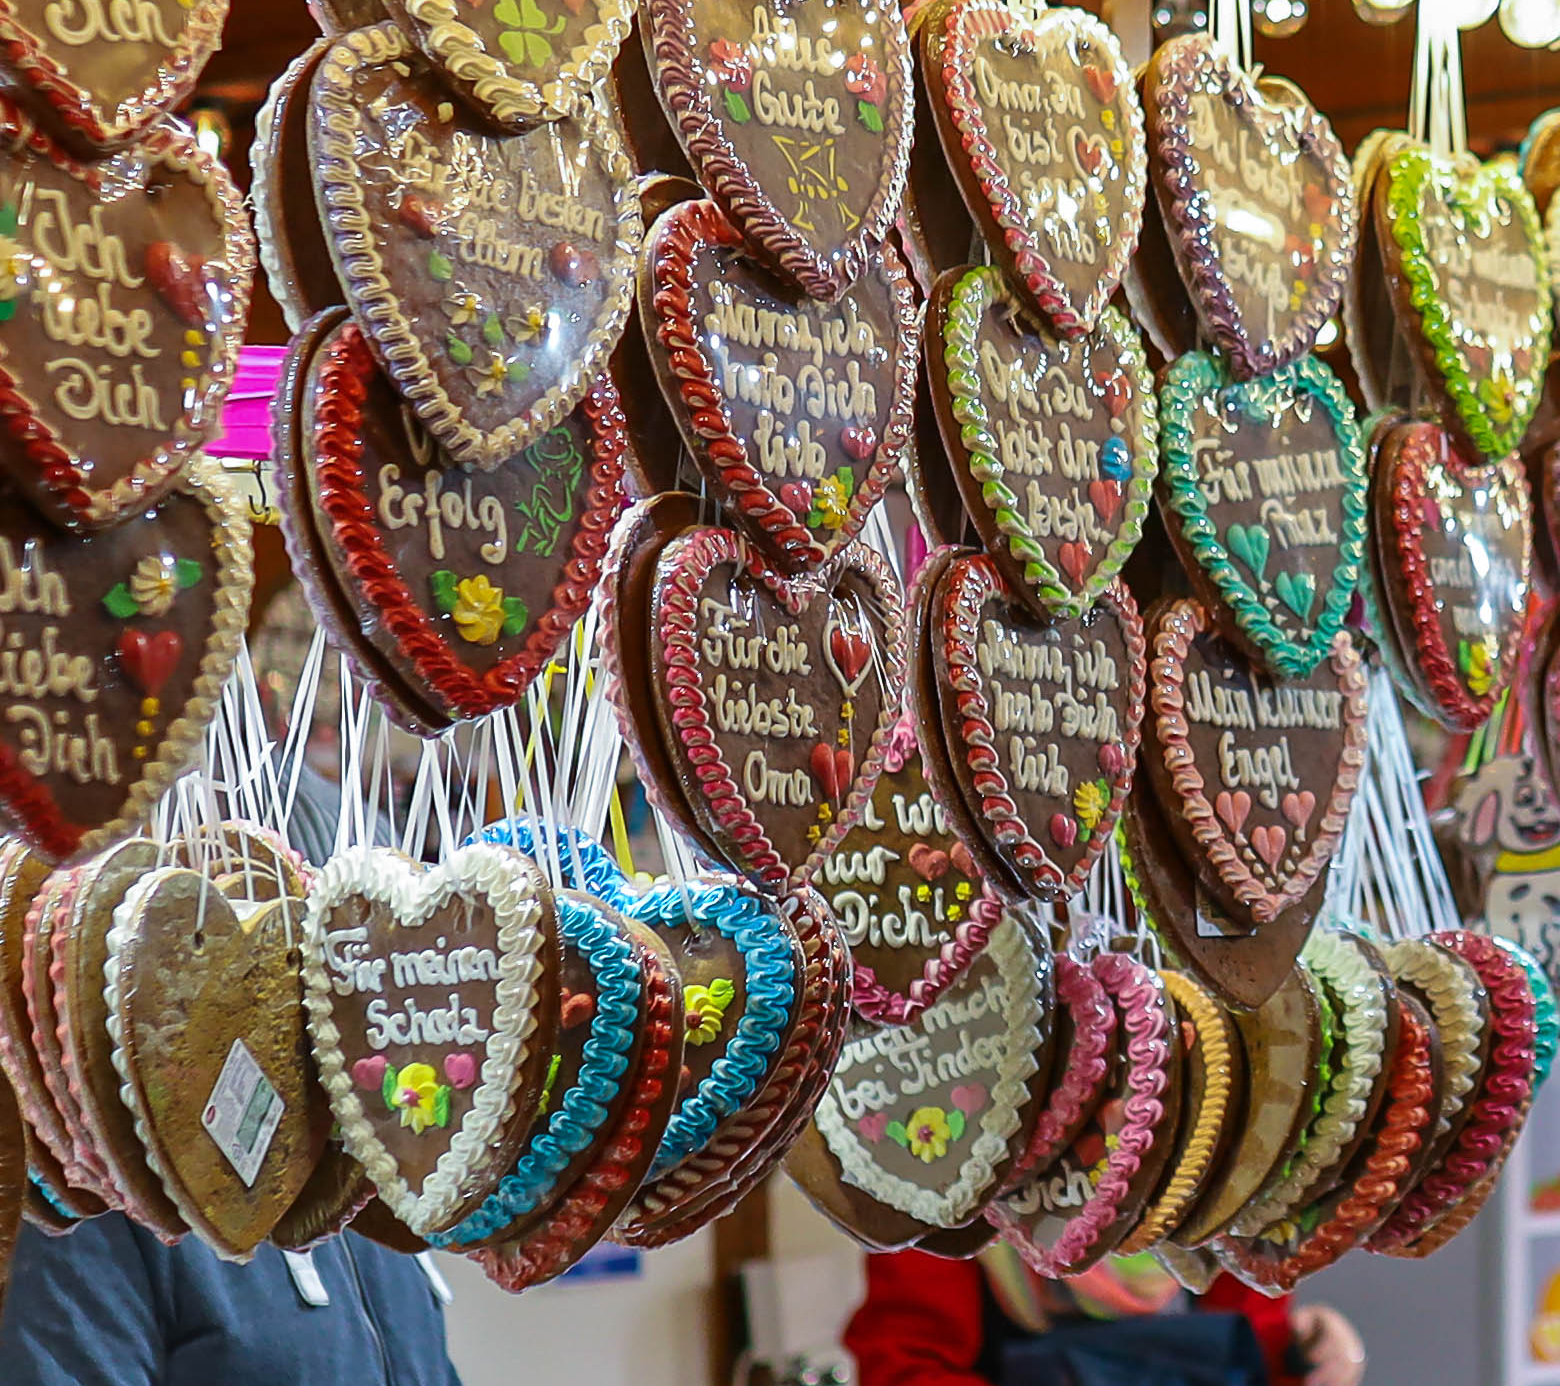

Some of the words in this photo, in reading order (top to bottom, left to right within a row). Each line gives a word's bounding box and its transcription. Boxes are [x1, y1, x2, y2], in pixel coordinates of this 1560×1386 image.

[752, 69, 846, 136] Gute
[974, 56, 1046, 112] Oma,
[1043, 70, 1086, 120] Du
[1006, 114, 1064, 165] bist
[30, 185, 142, 289] Ich
[517, 169, 604, 243] besten
[48, 355, 167, 431] Dich
[797, 360, 877, 419] Dich
[1045, 366, 1093, 420] Du
[754, 412, 826, 484] lieb
[996, 410, 1053, 477] bist
[1056, 421, 1100, 481] der
[1192, 438, 1252, 504] Für
[1251, 435, 1347, 497] meinen
[378, 463, 508, 563] Erfolg
[700, 596, 758, 669] Für
[766, 623, 812, 676] die
[1057, 633, 1119, 690] ich
[708, 674, 819, 737] liebste
[990, 679, 1055, 733] hab
[1053, 686, 1122, 742] Dich
[1186, 668, 1256, 731] Mein
[2, 701, 122, 783] Dich
[1009, 734, 1070, 796] lieb
[1218, 730, 1301, 810] Engel
[743, 750, 814, 805] Oma
[324, 926, 388, 996] Für
[390, 936, 504, 990] meinen
[366, 992, 490, 1050] Schatz
[921, 974, 1010, 1033] mich
[832, 1062, 898, 1121] bei
